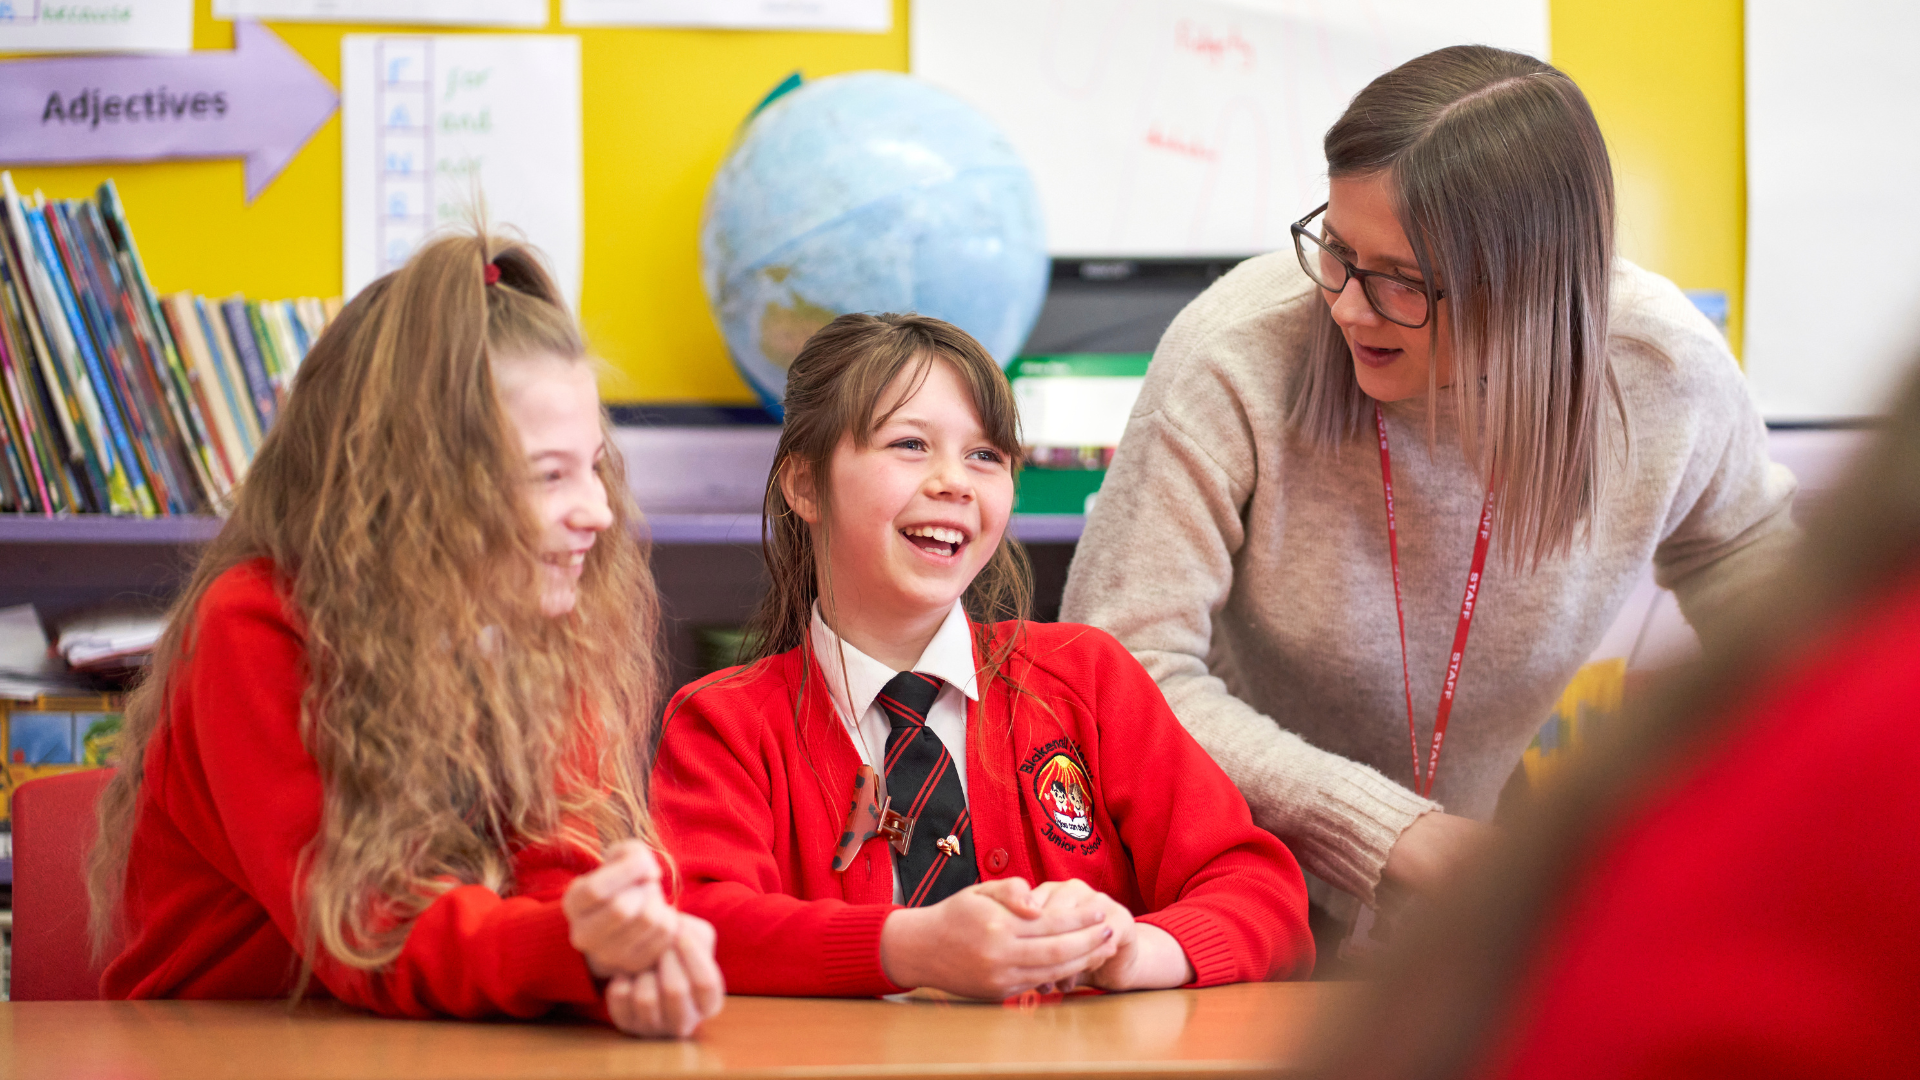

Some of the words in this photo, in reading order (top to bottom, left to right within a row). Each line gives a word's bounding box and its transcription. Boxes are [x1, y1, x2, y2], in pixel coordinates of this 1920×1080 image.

[444, 66, 493, 101] for
[42, 86, 228, 131] Adjectives
[438, 105, 492, 133] and
[1462, 571, 1479, 620] STAFF
[1444, 652, 1461, 700] STAFF
[1427, 732, 1443, 779] STAFF
[1041, 822, 1076, 853] Junior
[1080, 833, 1102, 856] School
